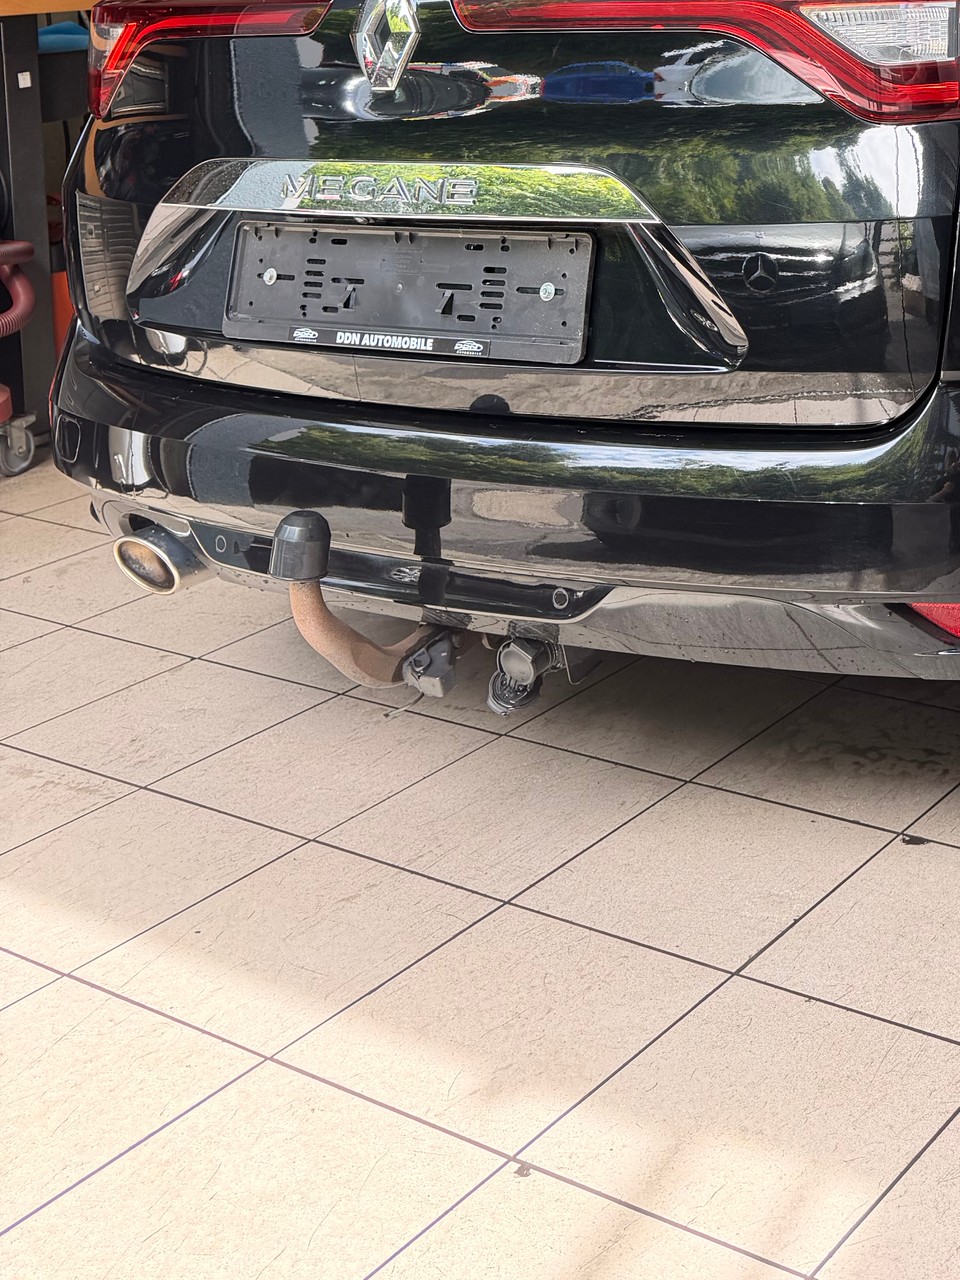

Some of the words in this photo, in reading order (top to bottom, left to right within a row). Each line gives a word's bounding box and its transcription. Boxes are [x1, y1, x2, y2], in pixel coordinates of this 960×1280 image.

[280, 173, 480, 206] MEGANE
[336, 331, 361, 345] DDN
[361, 333, 434, 351] AUTOMOBILE
